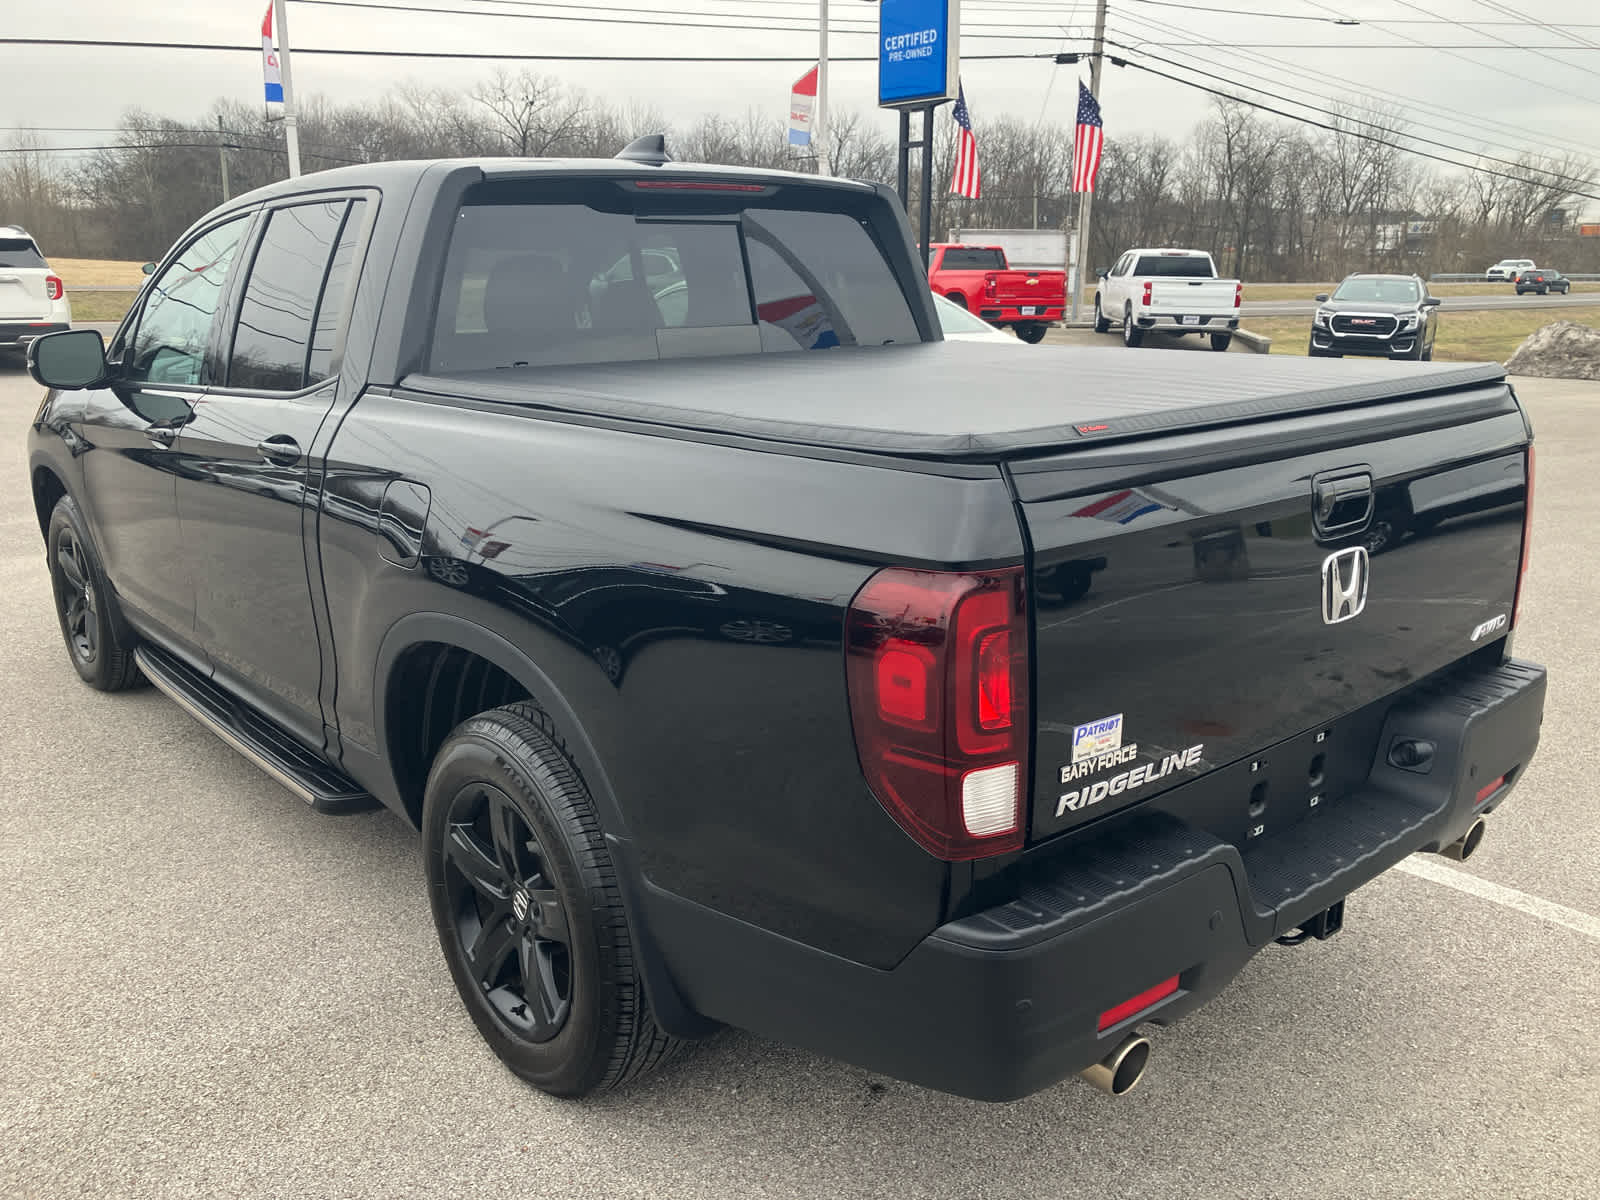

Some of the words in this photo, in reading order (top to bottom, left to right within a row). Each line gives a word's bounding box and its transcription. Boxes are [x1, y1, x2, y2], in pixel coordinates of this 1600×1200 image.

[885, 28, 938, 51] CERTIFIED
[888, 46, 933, 62] PRE-OWNED
[1075, 718, 1121, 746] PATRIOT
[1061, 757, 1099, 784] GARY
[1097, 743, 1138, 771] FORCE
[1055, 743, 1204, 817] RIDGELINE
